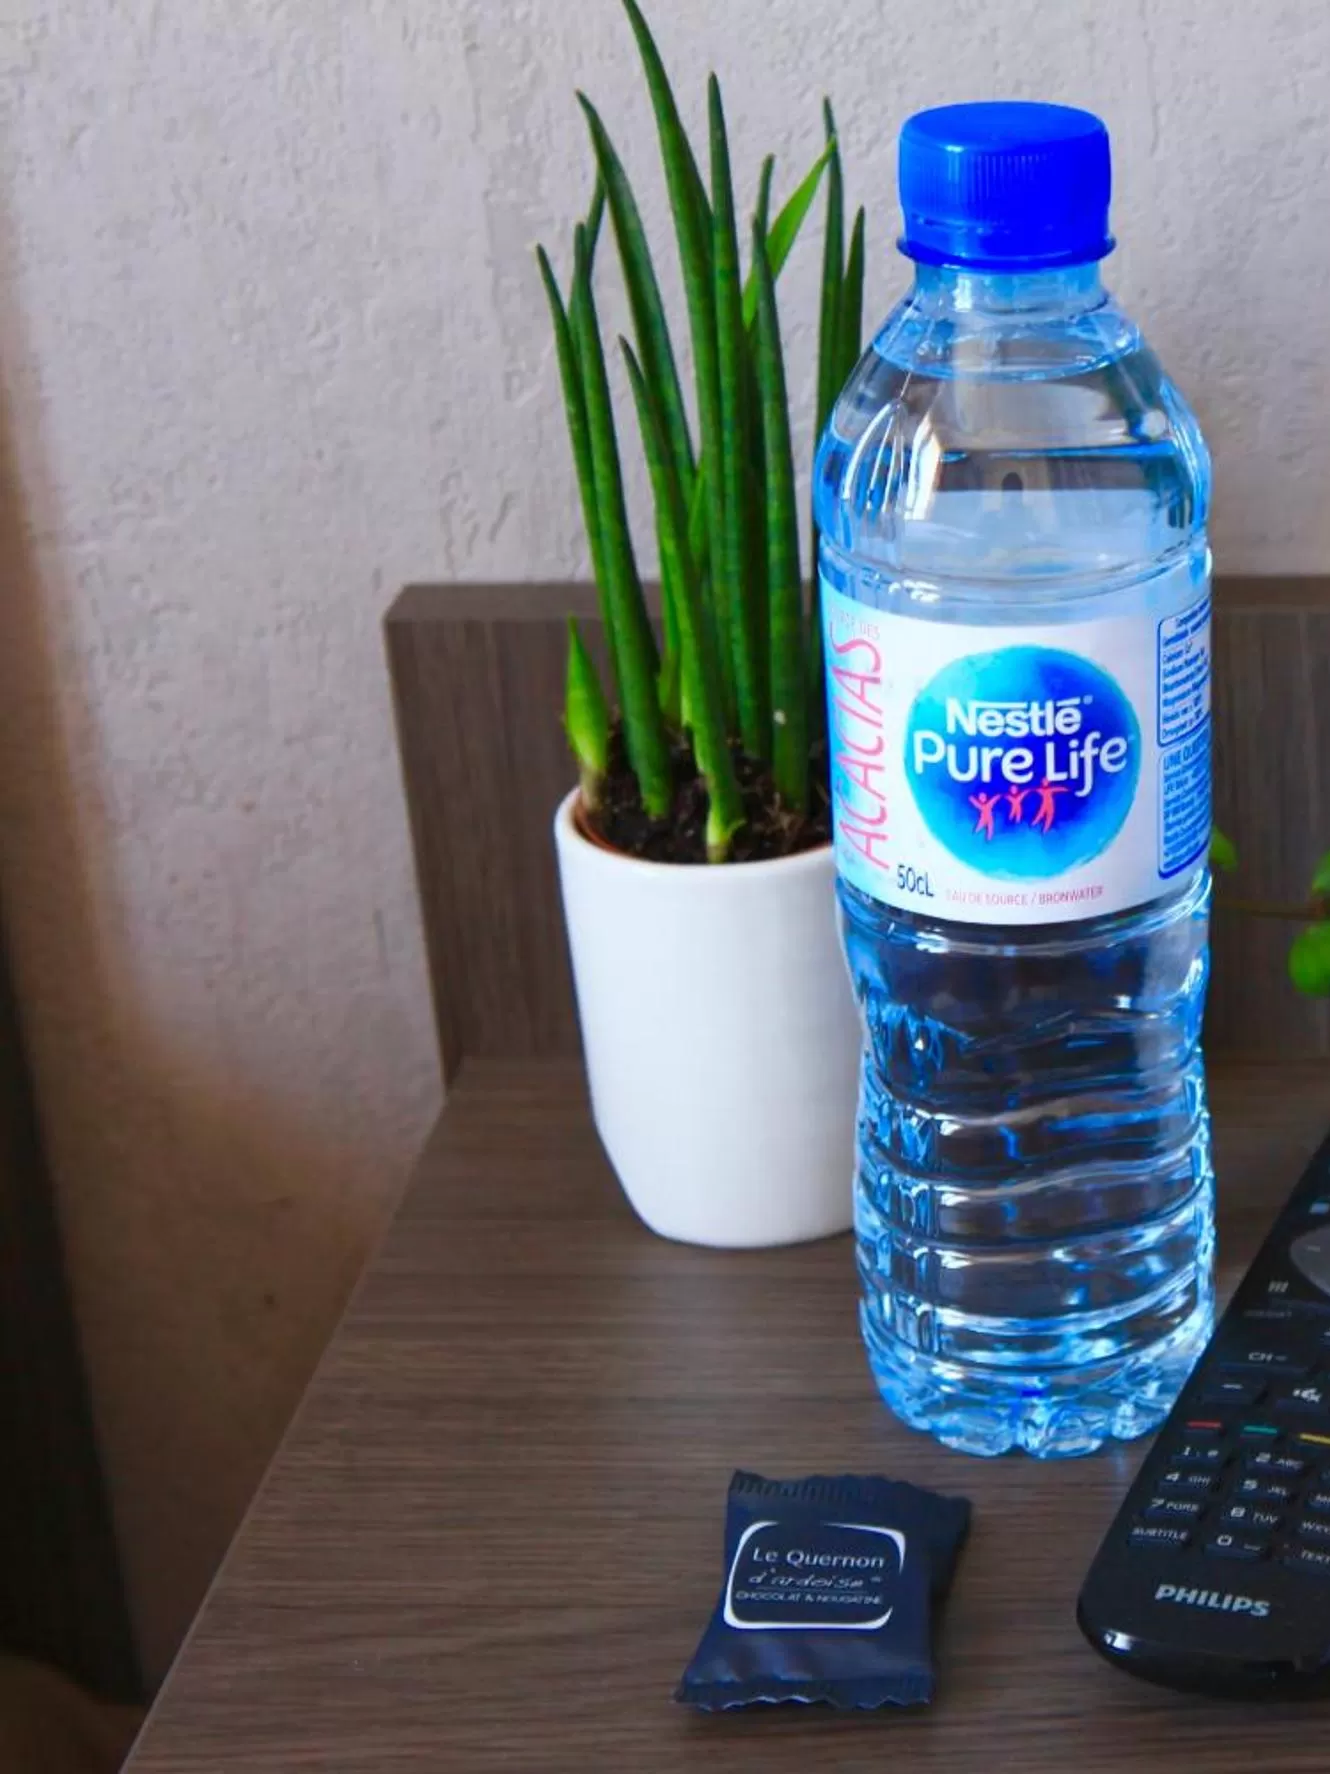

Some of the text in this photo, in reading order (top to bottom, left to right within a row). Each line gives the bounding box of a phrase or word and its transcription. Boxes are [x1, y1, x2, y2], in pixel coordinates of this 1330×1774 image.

[830, 621, 888, 869] ACACIAS
[913, 730, 1034, 784] Pure
[1045, 731, 1128, 797] Life
[897, 864, 934, 897] 50cL
[986, 893, 1028, 906] SOURCE
[1039, 884, 1104, 906] BRONWATER
[752, 1547, 885, 1569] Le Quernon
[1155, 1583, 1271, 1617] PHILIPS
